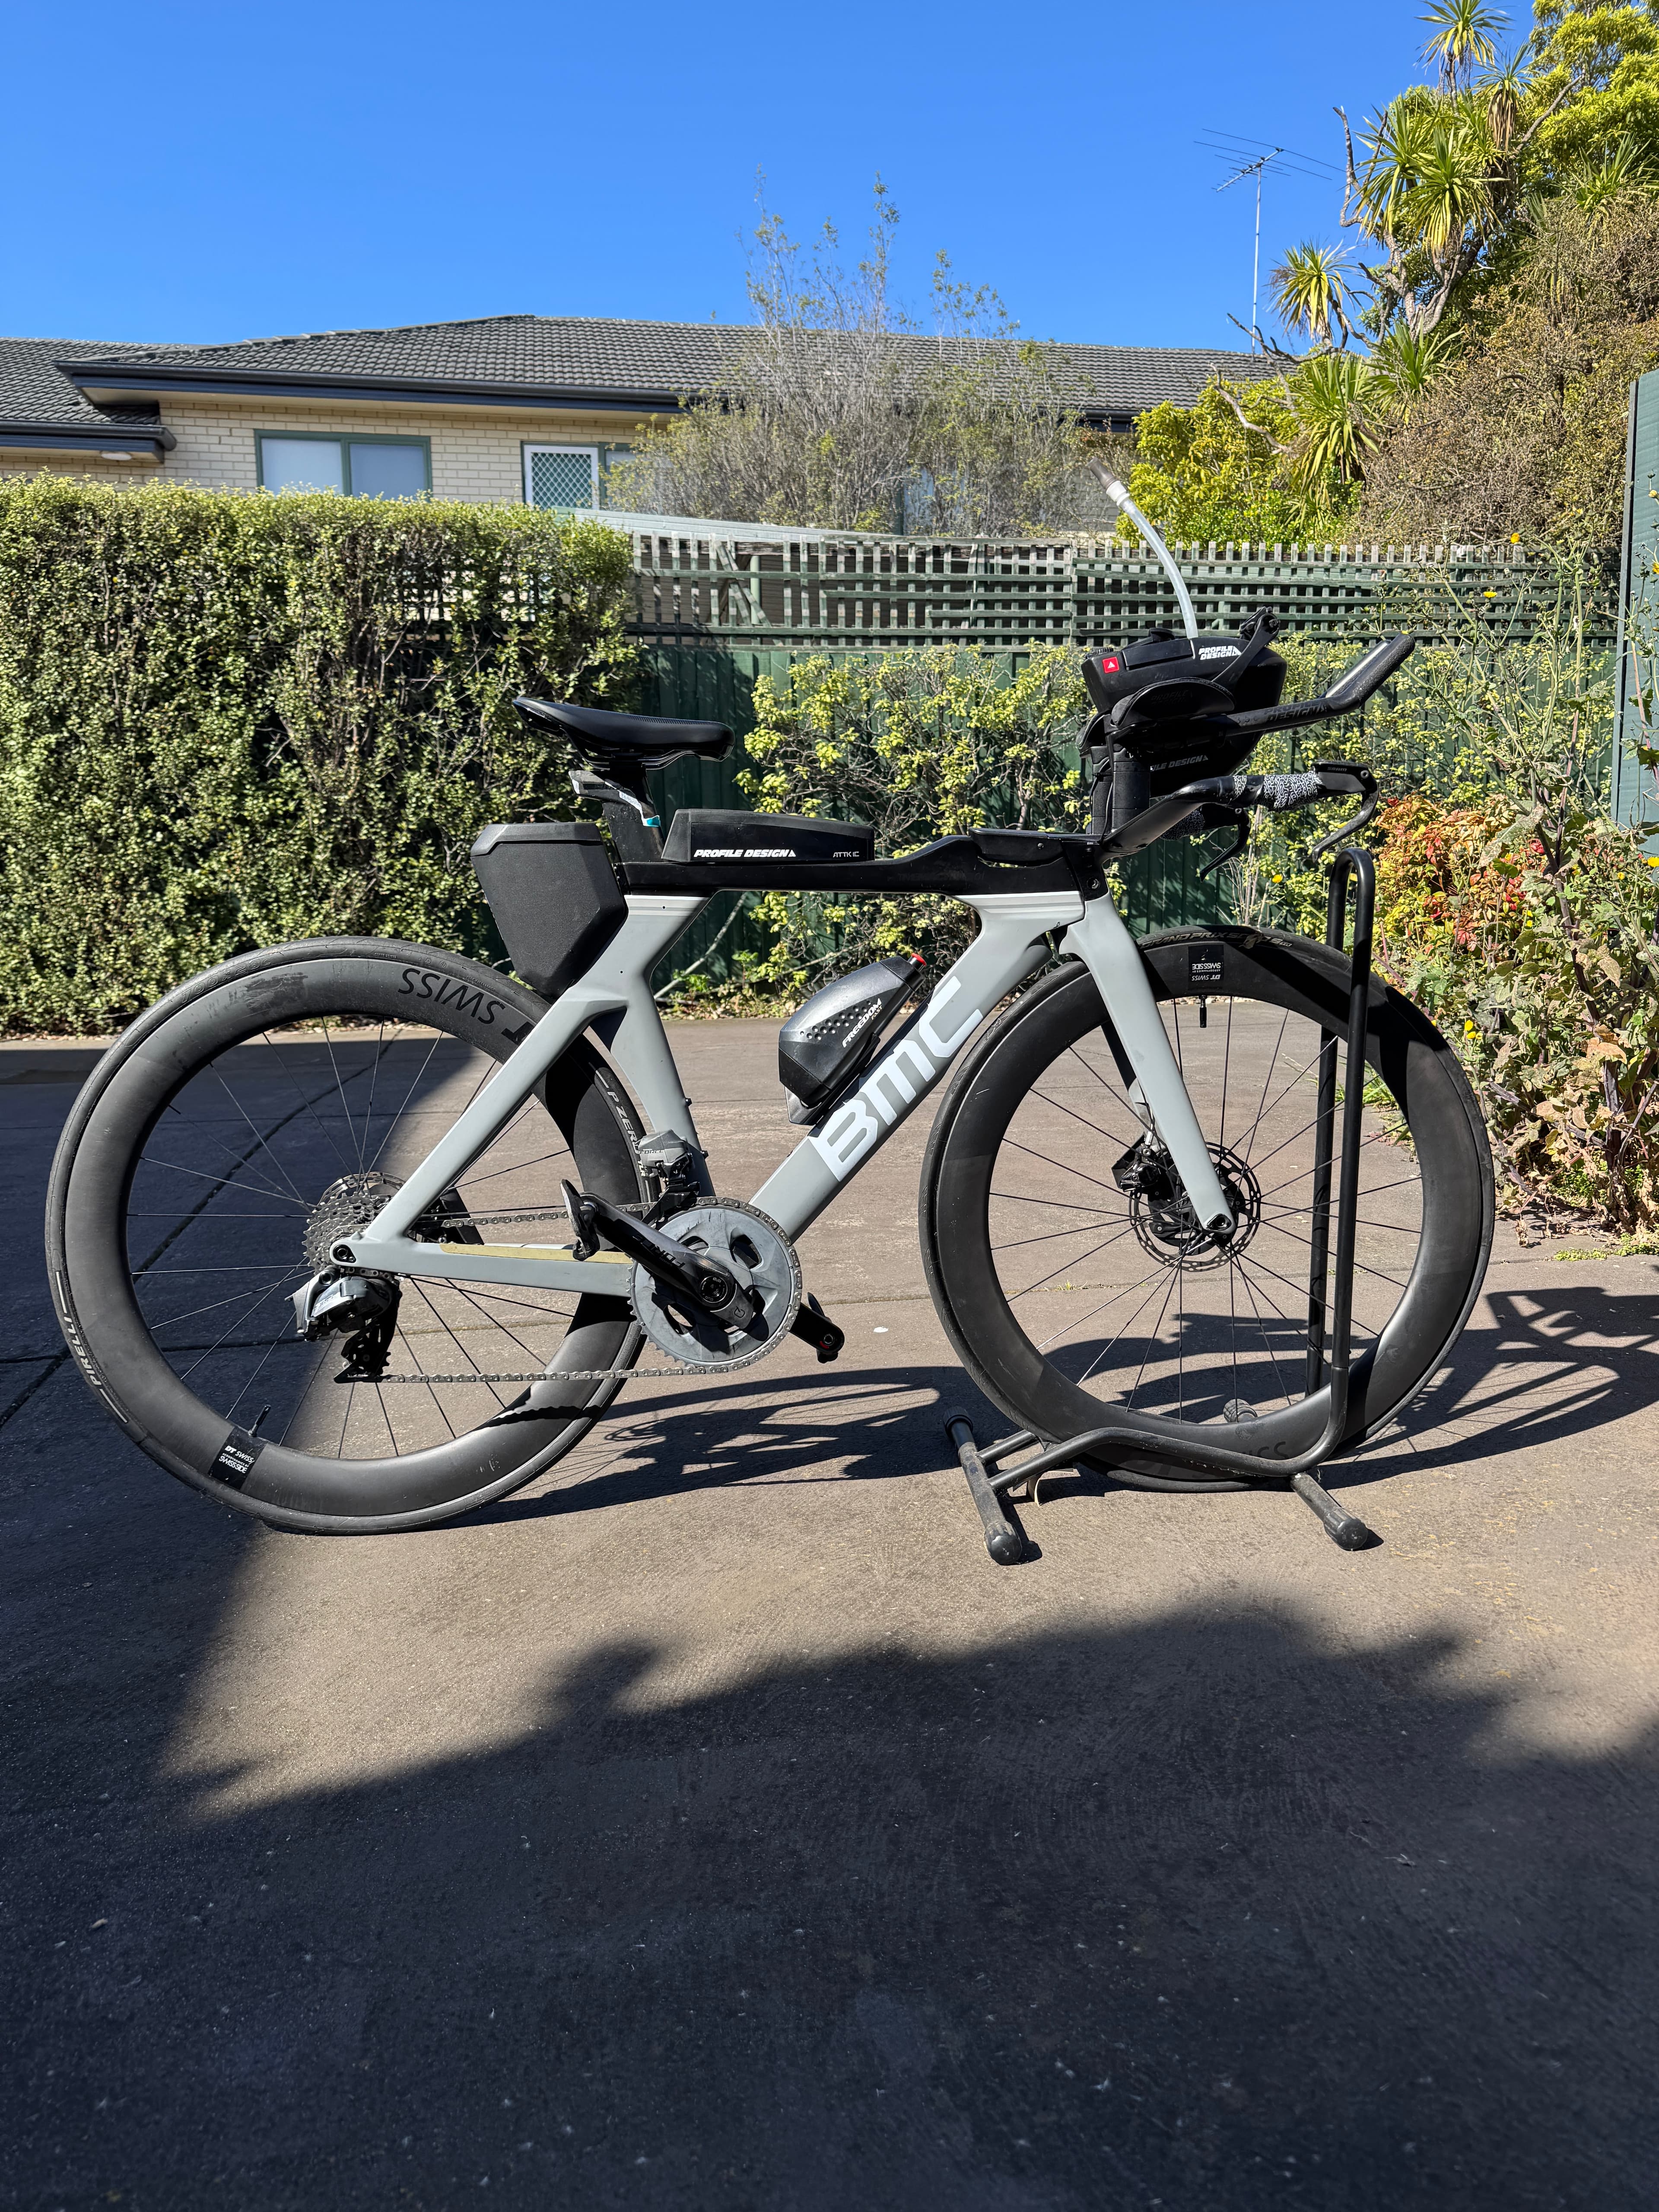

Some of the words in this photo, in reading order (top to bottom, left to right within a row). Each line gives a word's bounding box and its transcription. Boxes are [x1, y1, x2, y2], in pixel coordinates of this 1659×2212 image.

[1198, 645, 1233, 655] PROFILE
[1200, 651, 1232, 660] DESIGN
[1264, 701, 1321, 715] PROFILE
[1266, 706, 1319, 721] DESIGN
[1168, 755, 1203, 768] DESIGN
[693, 849, 744, 858] PROFILE
[744, 849, 790, 858] DESIGN
[1140, 934, 1189, 949] GRAND
[1189, 931, 1228, 940] PRIX
[397, 968, 506, 1024] SWISS
[871, 1005, 882, 1020] FAST
[842, 998, 882, 1048] FREEDOM
[808, 976, 984, 1182] BMC
[607, 1091, 620, 1103] P
[64, 1316, 102, 1386] PIRELLI
[225, 1445, 237, 1453] DT
[235, 1451, 254, 1463] SWISS
